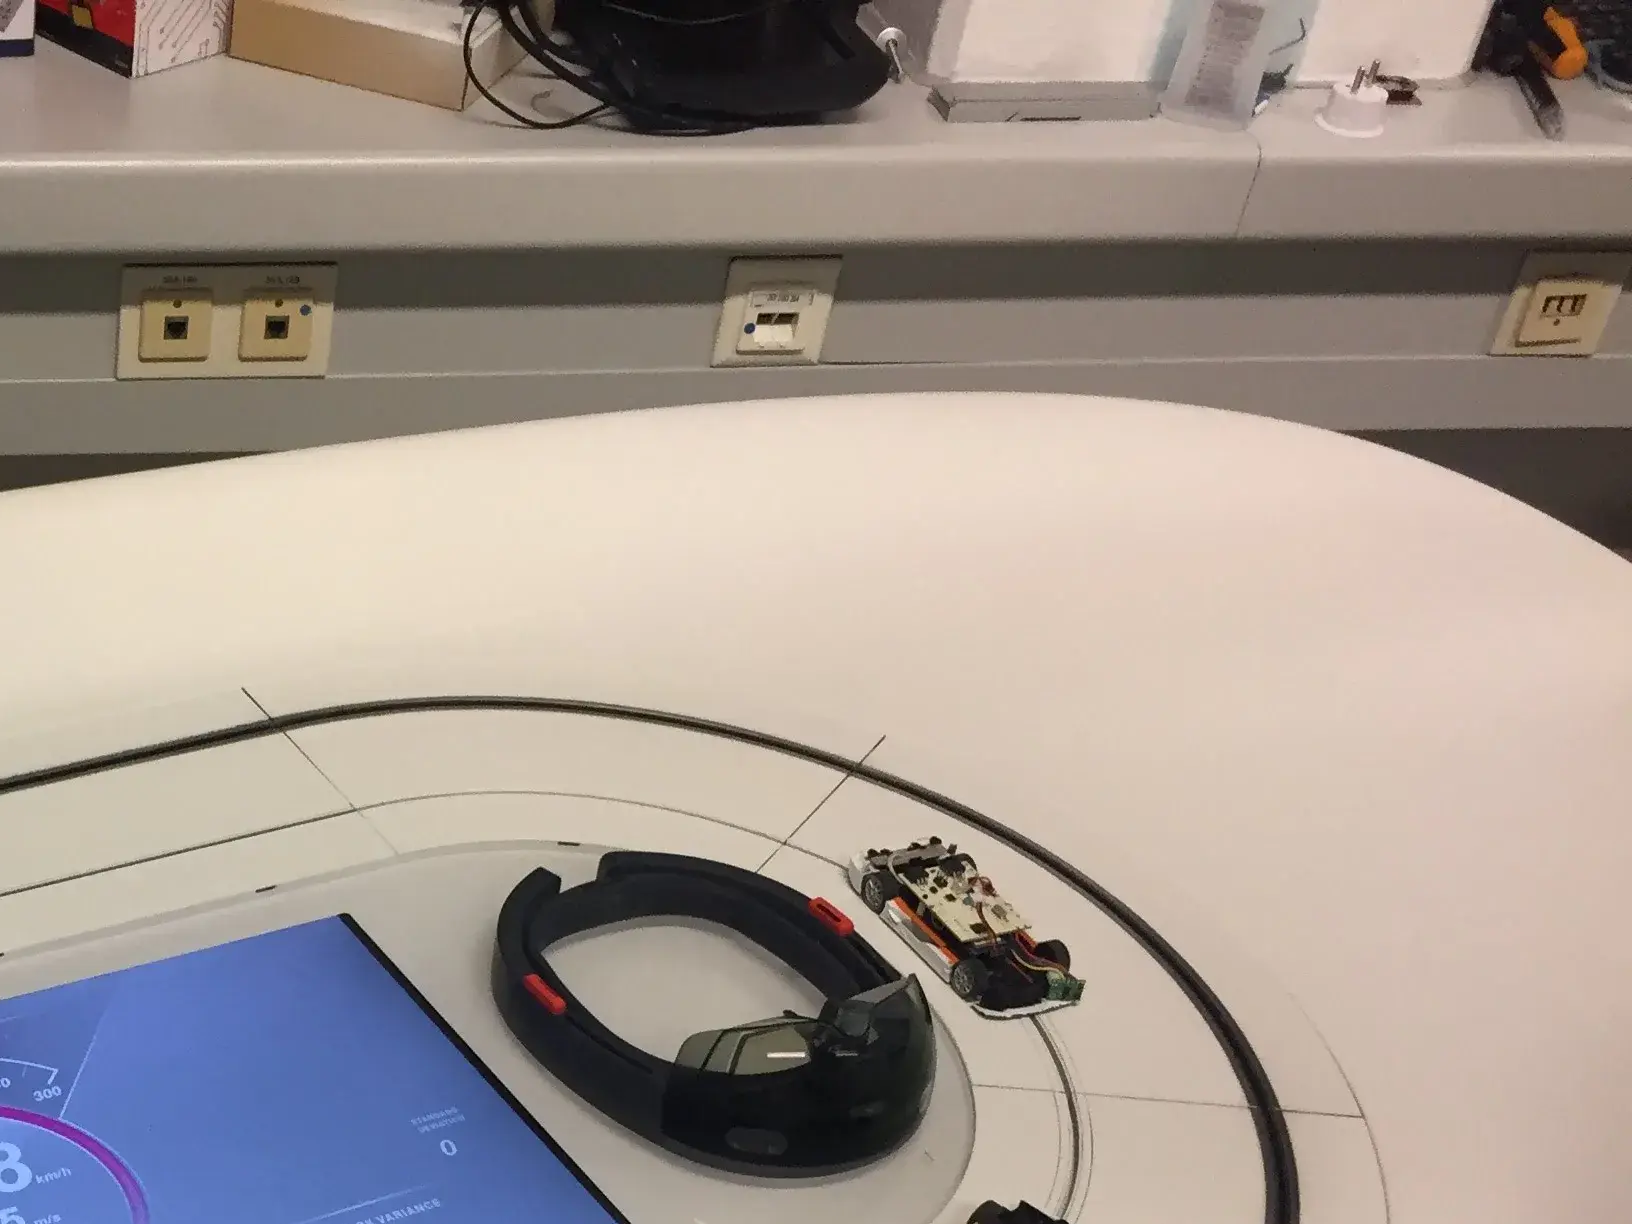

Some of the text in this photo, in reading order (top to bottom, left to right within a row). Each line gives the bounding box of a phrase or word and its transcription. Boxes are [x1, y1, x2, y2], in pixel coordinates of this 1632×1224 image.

[33, 1085, 63, 1102] 300
[439, 1139, 458, 1156] 0
[35, 1167, 72, 1185] km/h
[375, 1198, 441, 1224] VARIANCE
